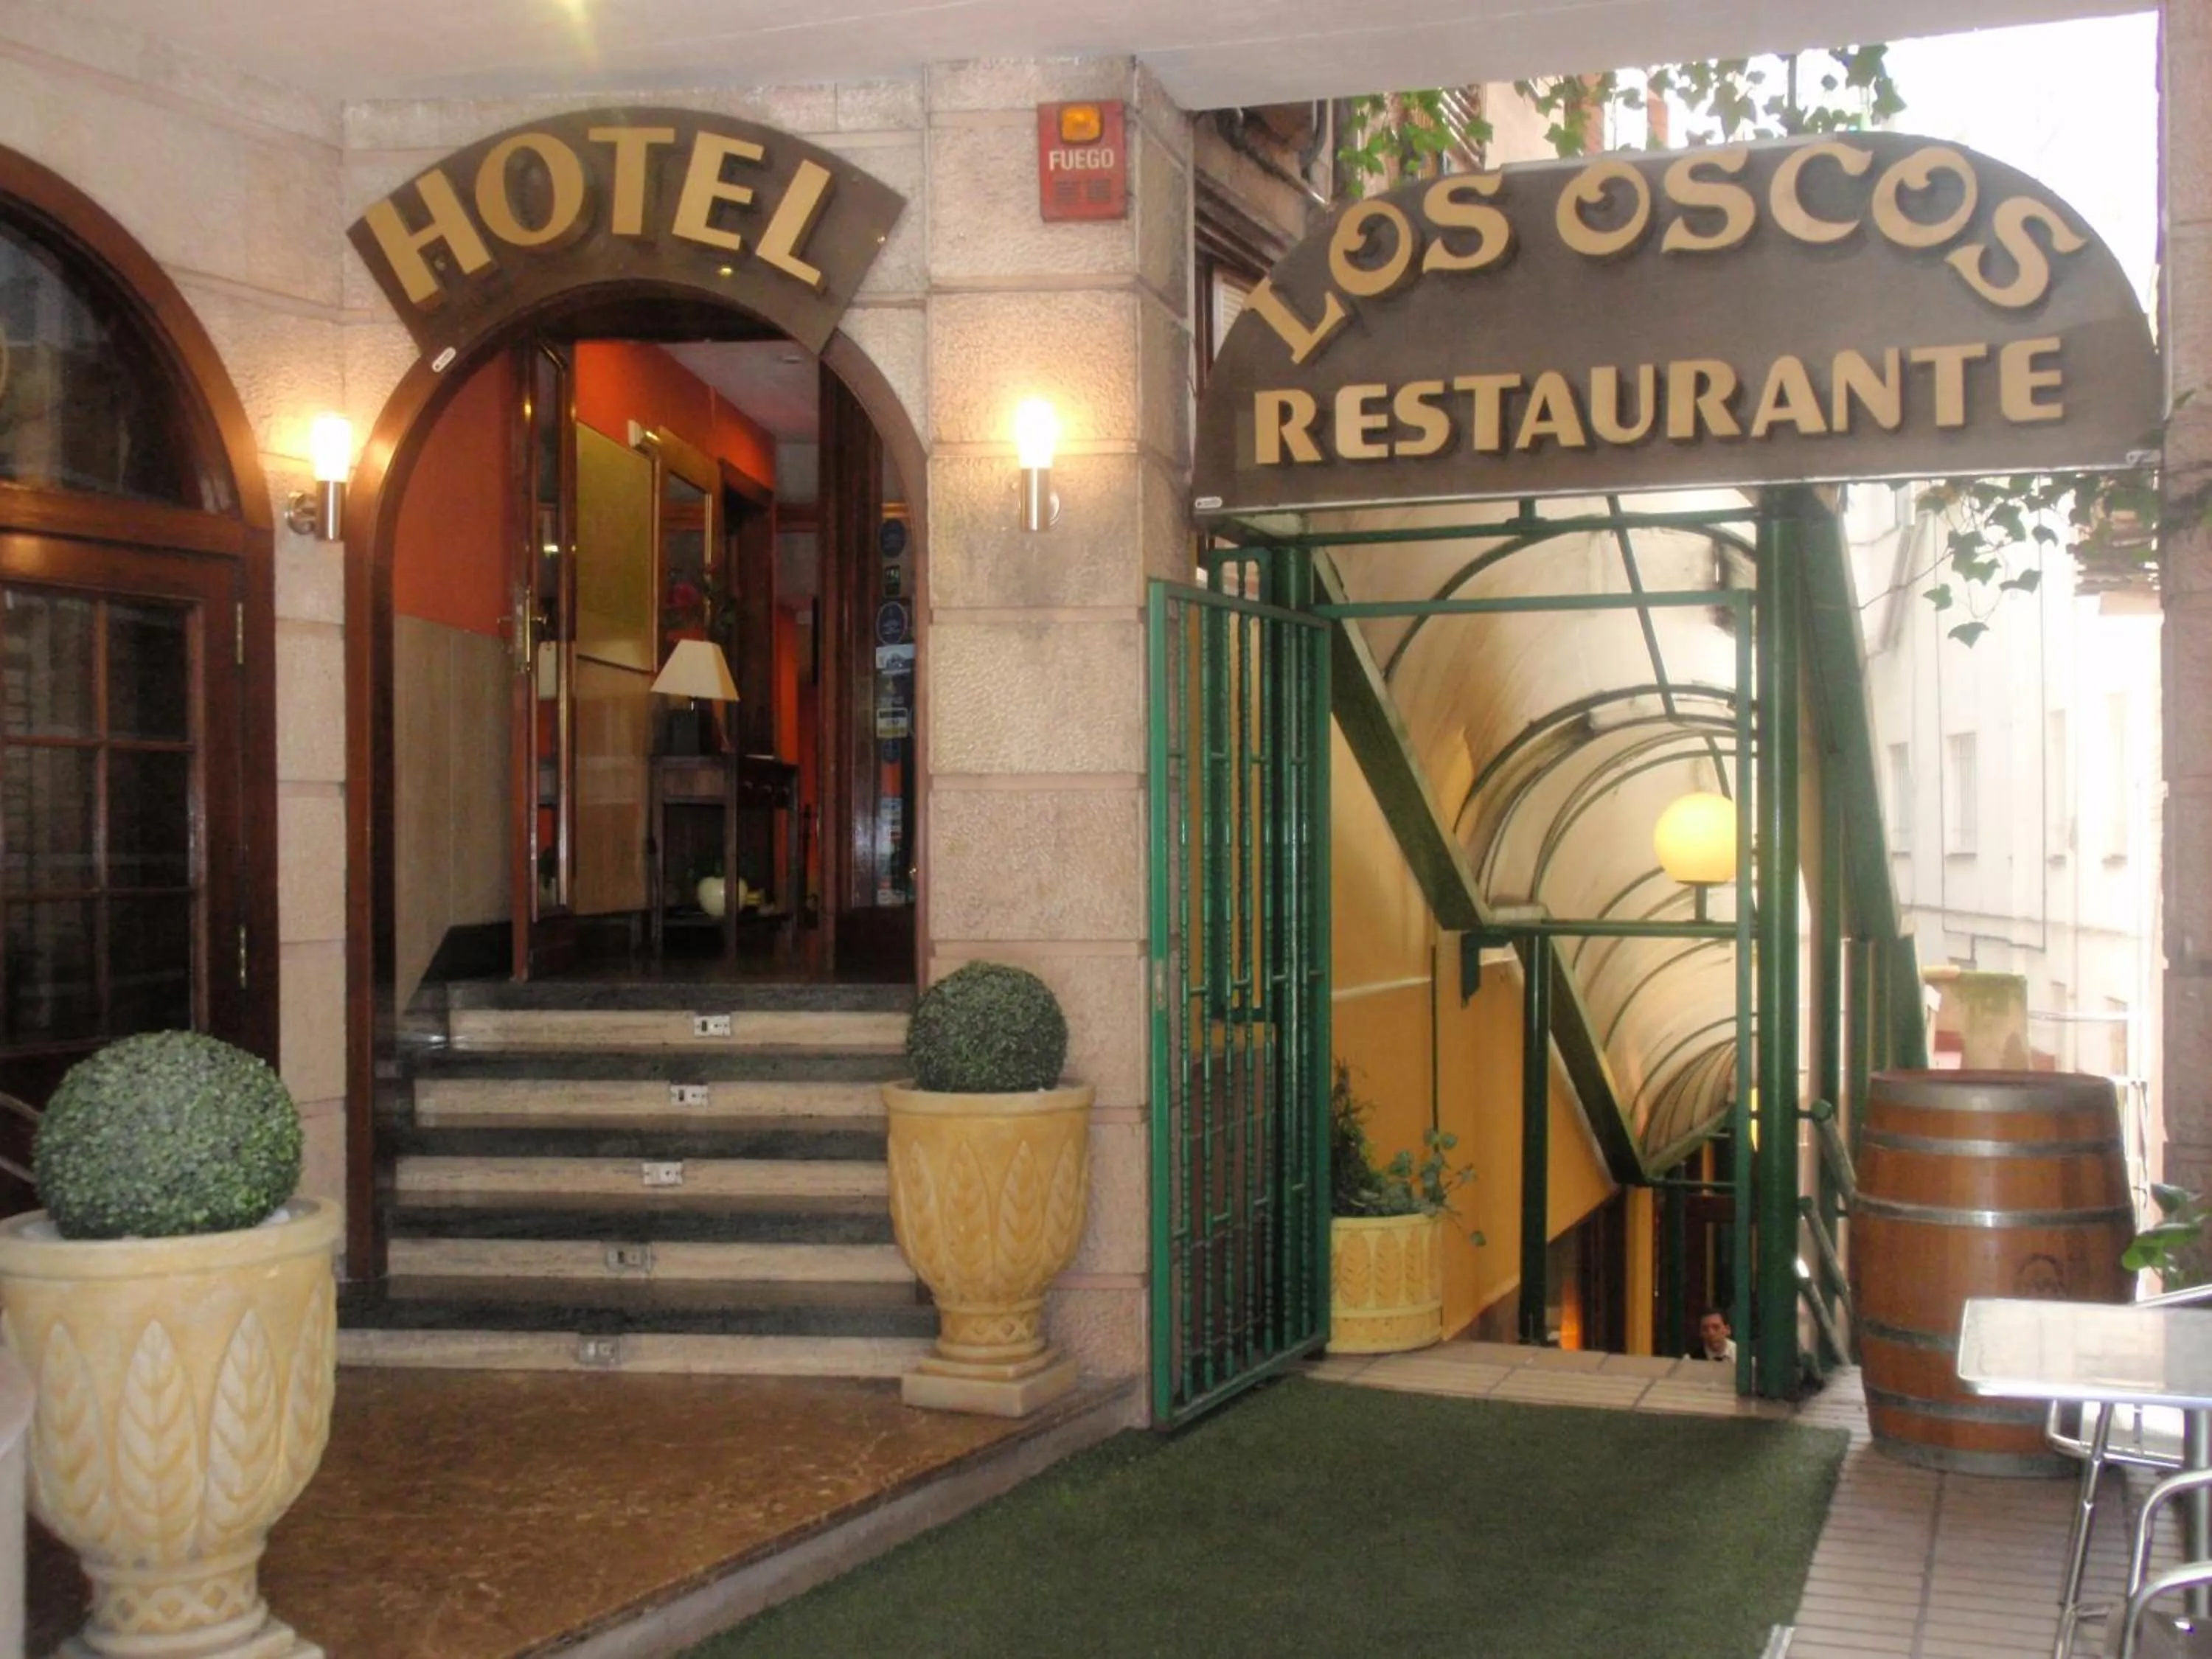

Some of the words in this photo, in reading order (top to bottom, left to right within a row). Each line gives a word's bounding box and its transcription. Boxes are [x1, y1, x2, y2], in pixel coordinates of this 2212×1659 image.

[362, 127, 831, 303] HOTEL
[1048, 149, 1114, 171] FUEGO
[1246, 173, 1512, 364] LOS
[1556, 143, 2087, 307] OSCOS
[1254, 337, 2065, 465] RESTAURANTE
